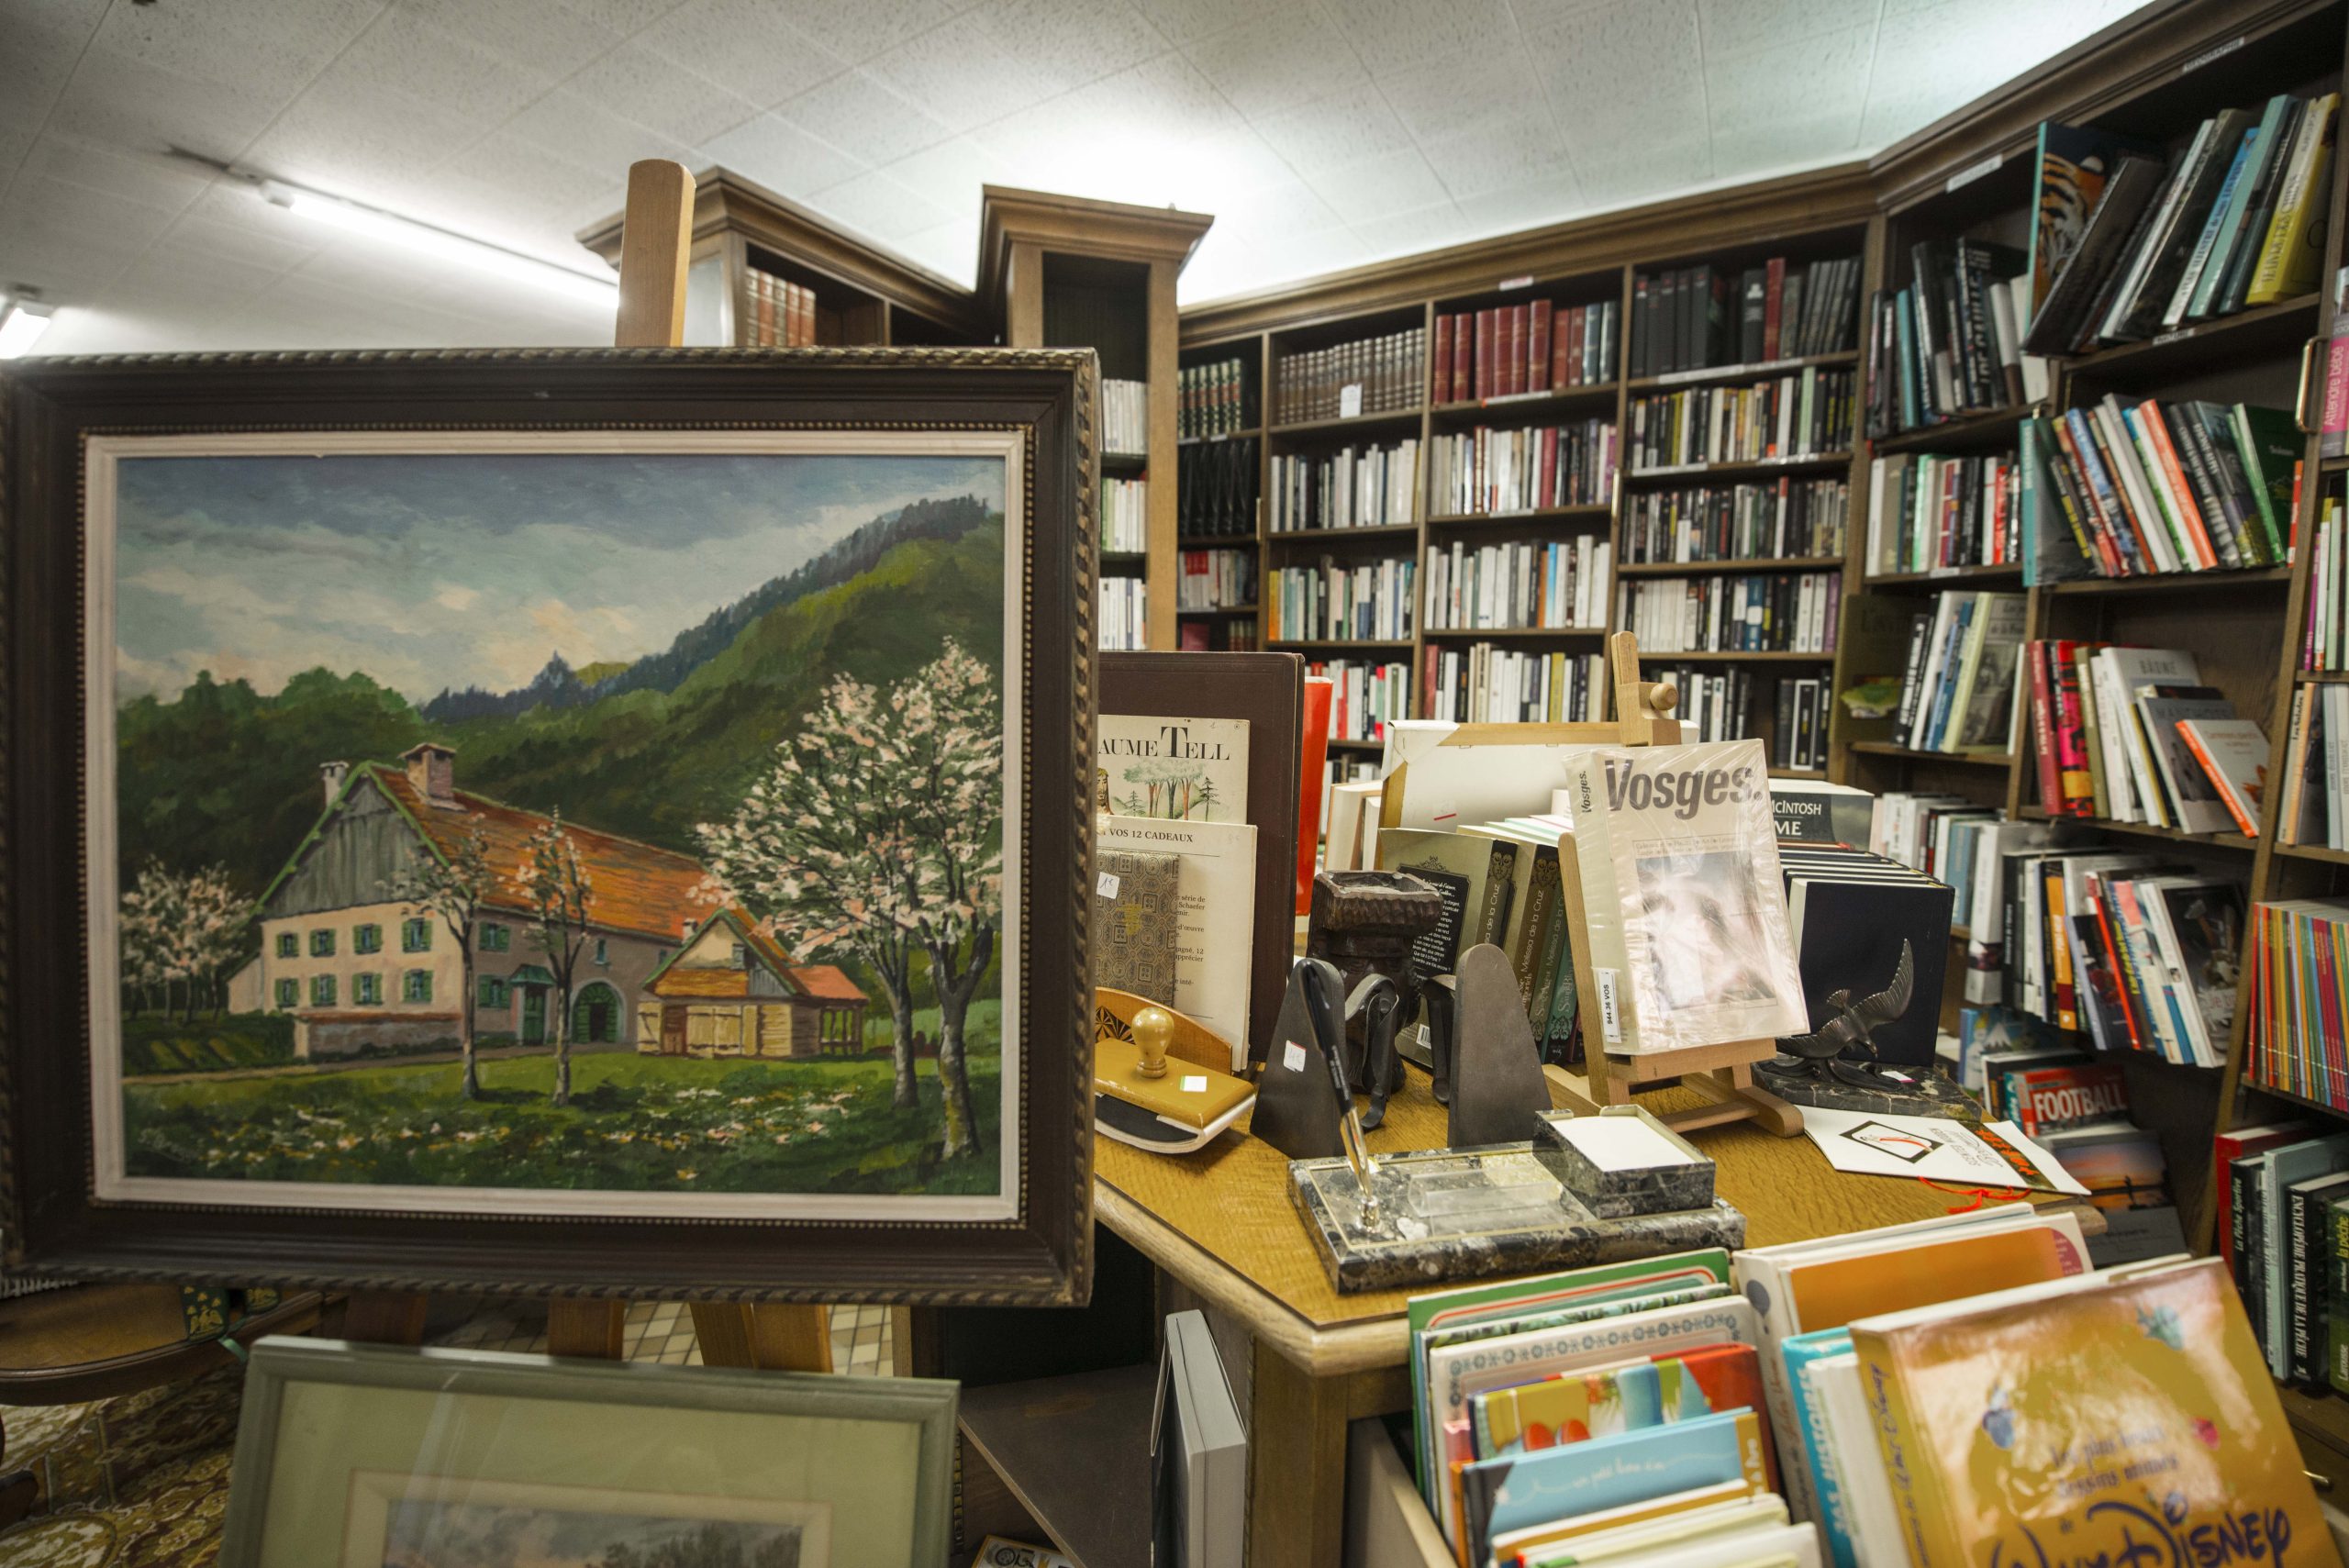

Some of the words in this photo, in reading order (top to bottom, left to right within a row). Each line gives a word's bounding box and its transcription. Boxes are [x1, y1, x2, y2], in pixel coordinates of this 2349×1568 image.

[2329, 346, 2344, 377] bébé
[2323, 378, 2341, 426] Attendre
[1098, 738, 1158, 757] AUME
[1161, 726, 1230, 761] TELL
[1578, 770, 1593, 814] Vosges.
[1604, 759, 1764, 820] Vosges.
[1109, 828, 1129, 838] VOS
[1131, 830, 1142, 839] 12
[1144, 830, 1194, 843] CADEAUX
[1181, 895, 1196, 903] série
[1490, 883, 1501, 905] Cruz
[1532, 889, 1545, 911] Cruz
[1178, 901, 1206, 911] Schaefer
[1487, 905, 1496, 916] la
[1531, 911, 1539, 923] la
[1486, 917, 1494, 930] de
[1529, 924, 1537, 938] de
[1520, 939, 1535, 973] Melissa
[2032, 1083, 2128, 1123] FOOTBALL
[2232, 1177, 2245, 1214] Sportive
[2292, 1260, 2307, 1301] PRATIQUE
[2294, 1302, 2307, 1314] DE
[2294, 1315, 2307, 1328] LA
[2295, 1328, 2310, 1359] PÊCHE
